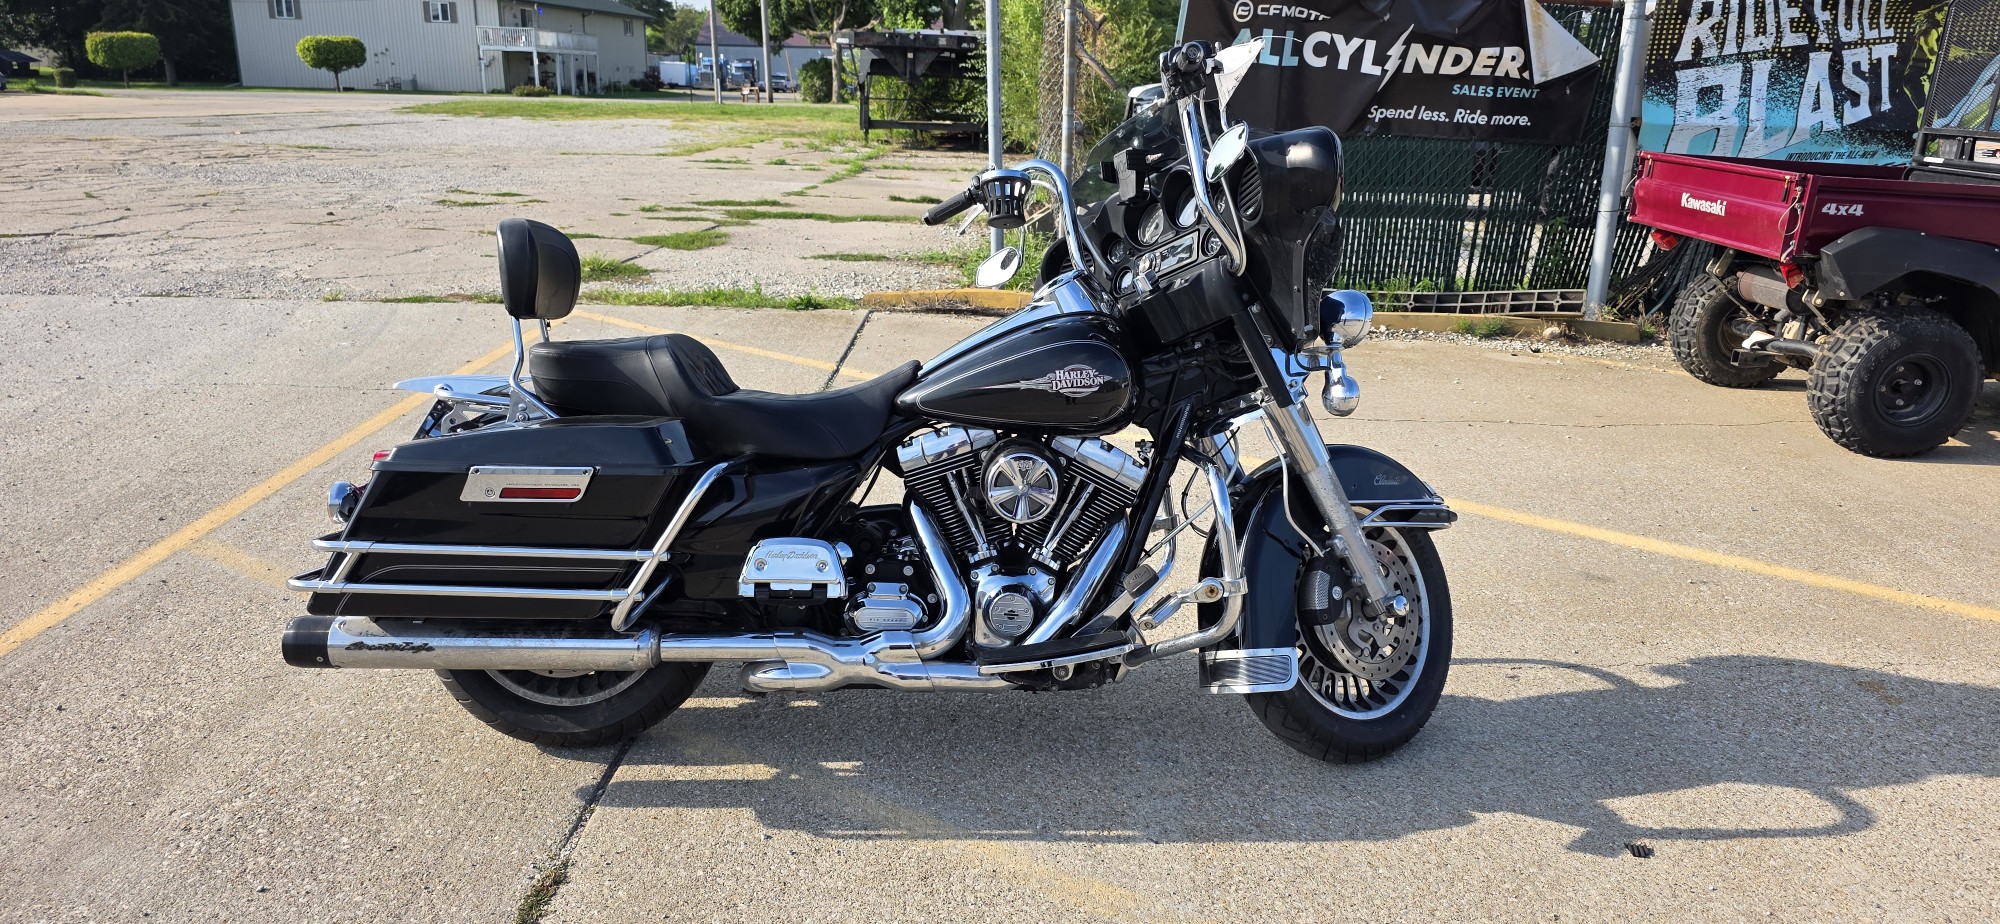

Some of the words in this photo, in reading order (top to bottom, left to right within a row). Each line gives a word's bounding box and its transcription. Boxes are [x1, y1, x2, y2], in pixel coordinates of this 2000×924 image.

[1674, 0, 1808, 62] RIDE
[1813, 0, 1894, 43] FULL
[1303, 24, 1530, 92] CYLINDER
[1452, 84, 1494, 97] SALES
[1496, 86, 1540, 98] EVENT
[1664, 43, 1897, 157] BLAST
[1367, 105, 1417, 122] Spend
[1418, 106, 1449, 122] less.
[1453, 108, 1488, 125] Ride
[1490, 115, 1531, 126] more.
[1785, 151, 1833, 161] INTRODUCING
[1833, 151, 1847, 160] THE
[1681, 192, 1727, 217] Kawasaki
[1821, 203, 1864, 217] 4x4
[1051, 376, 1105, 391] DAVIDSON
